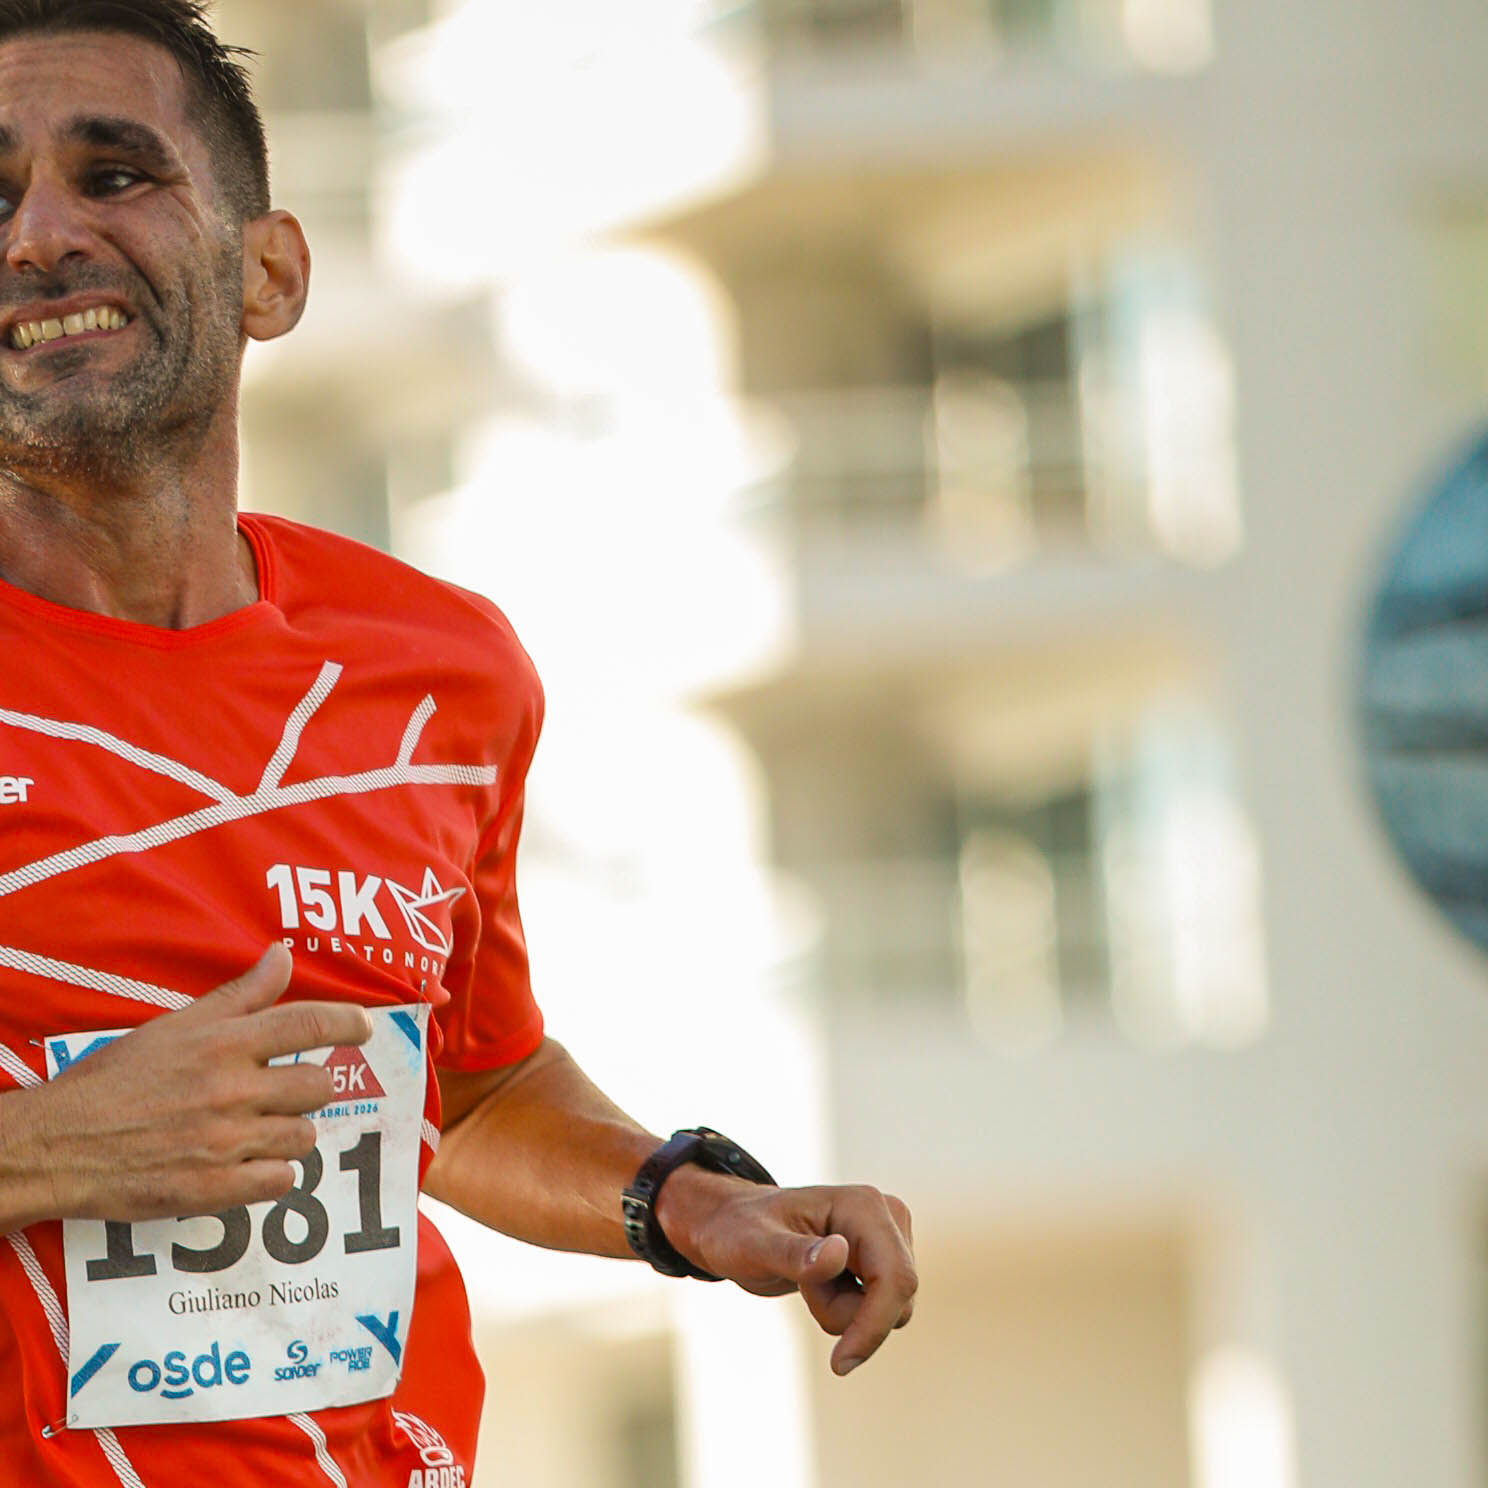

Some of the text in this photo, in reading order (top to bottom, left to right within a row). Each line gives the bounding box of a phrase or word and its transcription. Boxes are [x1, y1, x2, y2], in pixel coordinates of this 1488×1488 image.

[266, 863, 392, 939] 15K
[282, 937, 393, 964] PUETO
[325, 1063, 367, 1094] 5K
[320, 1107, 350, 1119] ABRIL
[353, 1103, 379, 1115] 2026
[168, 1277, 339, 1315] Giuliano Nicolas
[128, 1340, 251, 1395] osde
[329, 1346, 373, 1363] POWER
